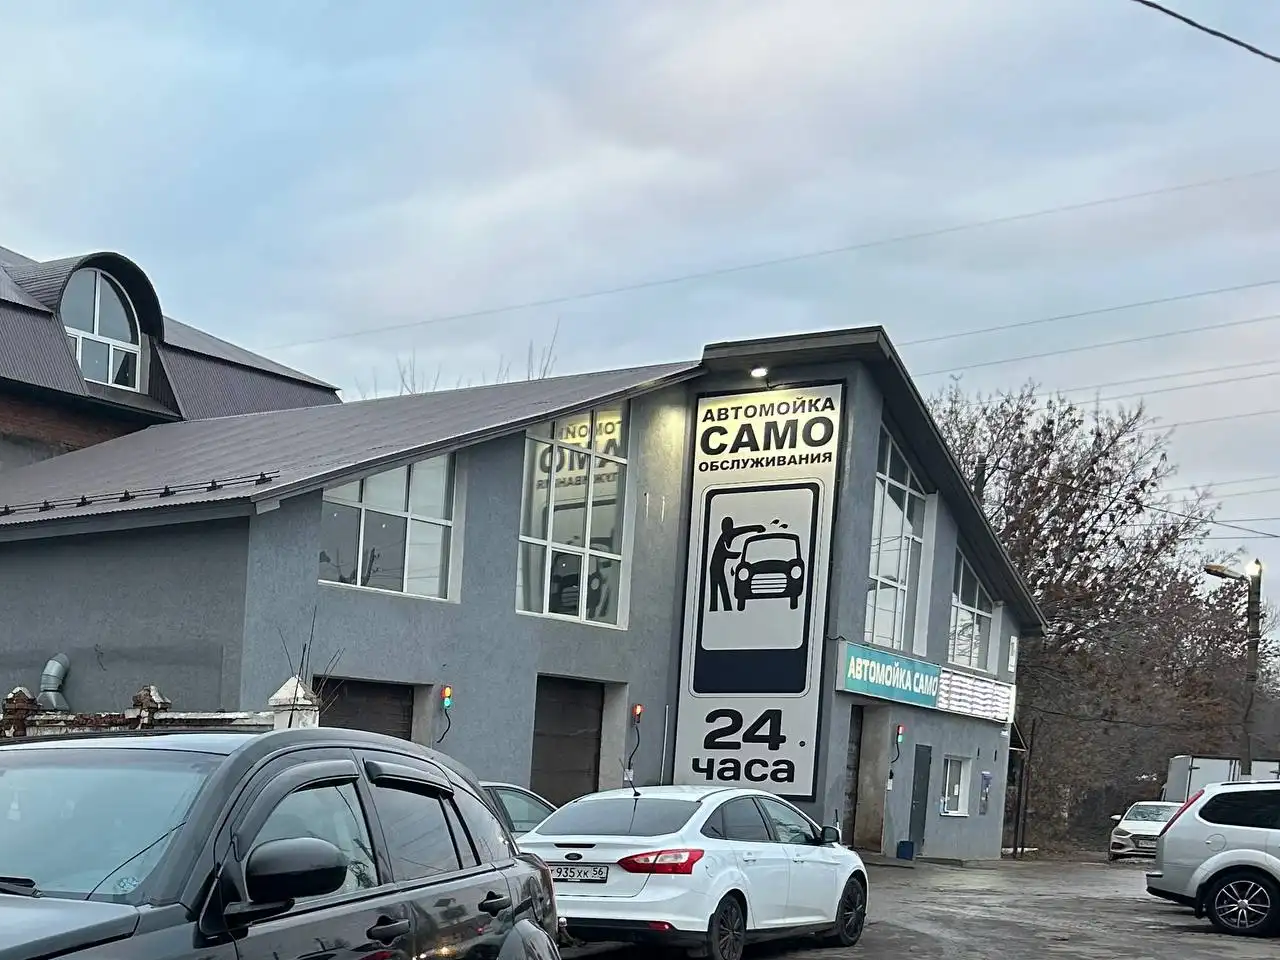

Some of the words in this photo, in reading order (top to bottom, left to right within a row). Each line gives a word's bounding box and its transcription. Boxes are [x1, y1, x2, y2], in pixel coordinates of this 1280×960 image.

[702, 397, 835, 422] АВТОМОЙКА
[699, 416, 834, 456] САМО
[698, 452, 833, 472] ОБСЛУЖИВАНИЯ
[847, 656, 912, 692] АВТОМОЙКА
[913, 672, 939, 697] САМО
[704, 708, 787, 750] 24
[692, 758, 795, 783] часа
[592, 867, 604, 876] 56
